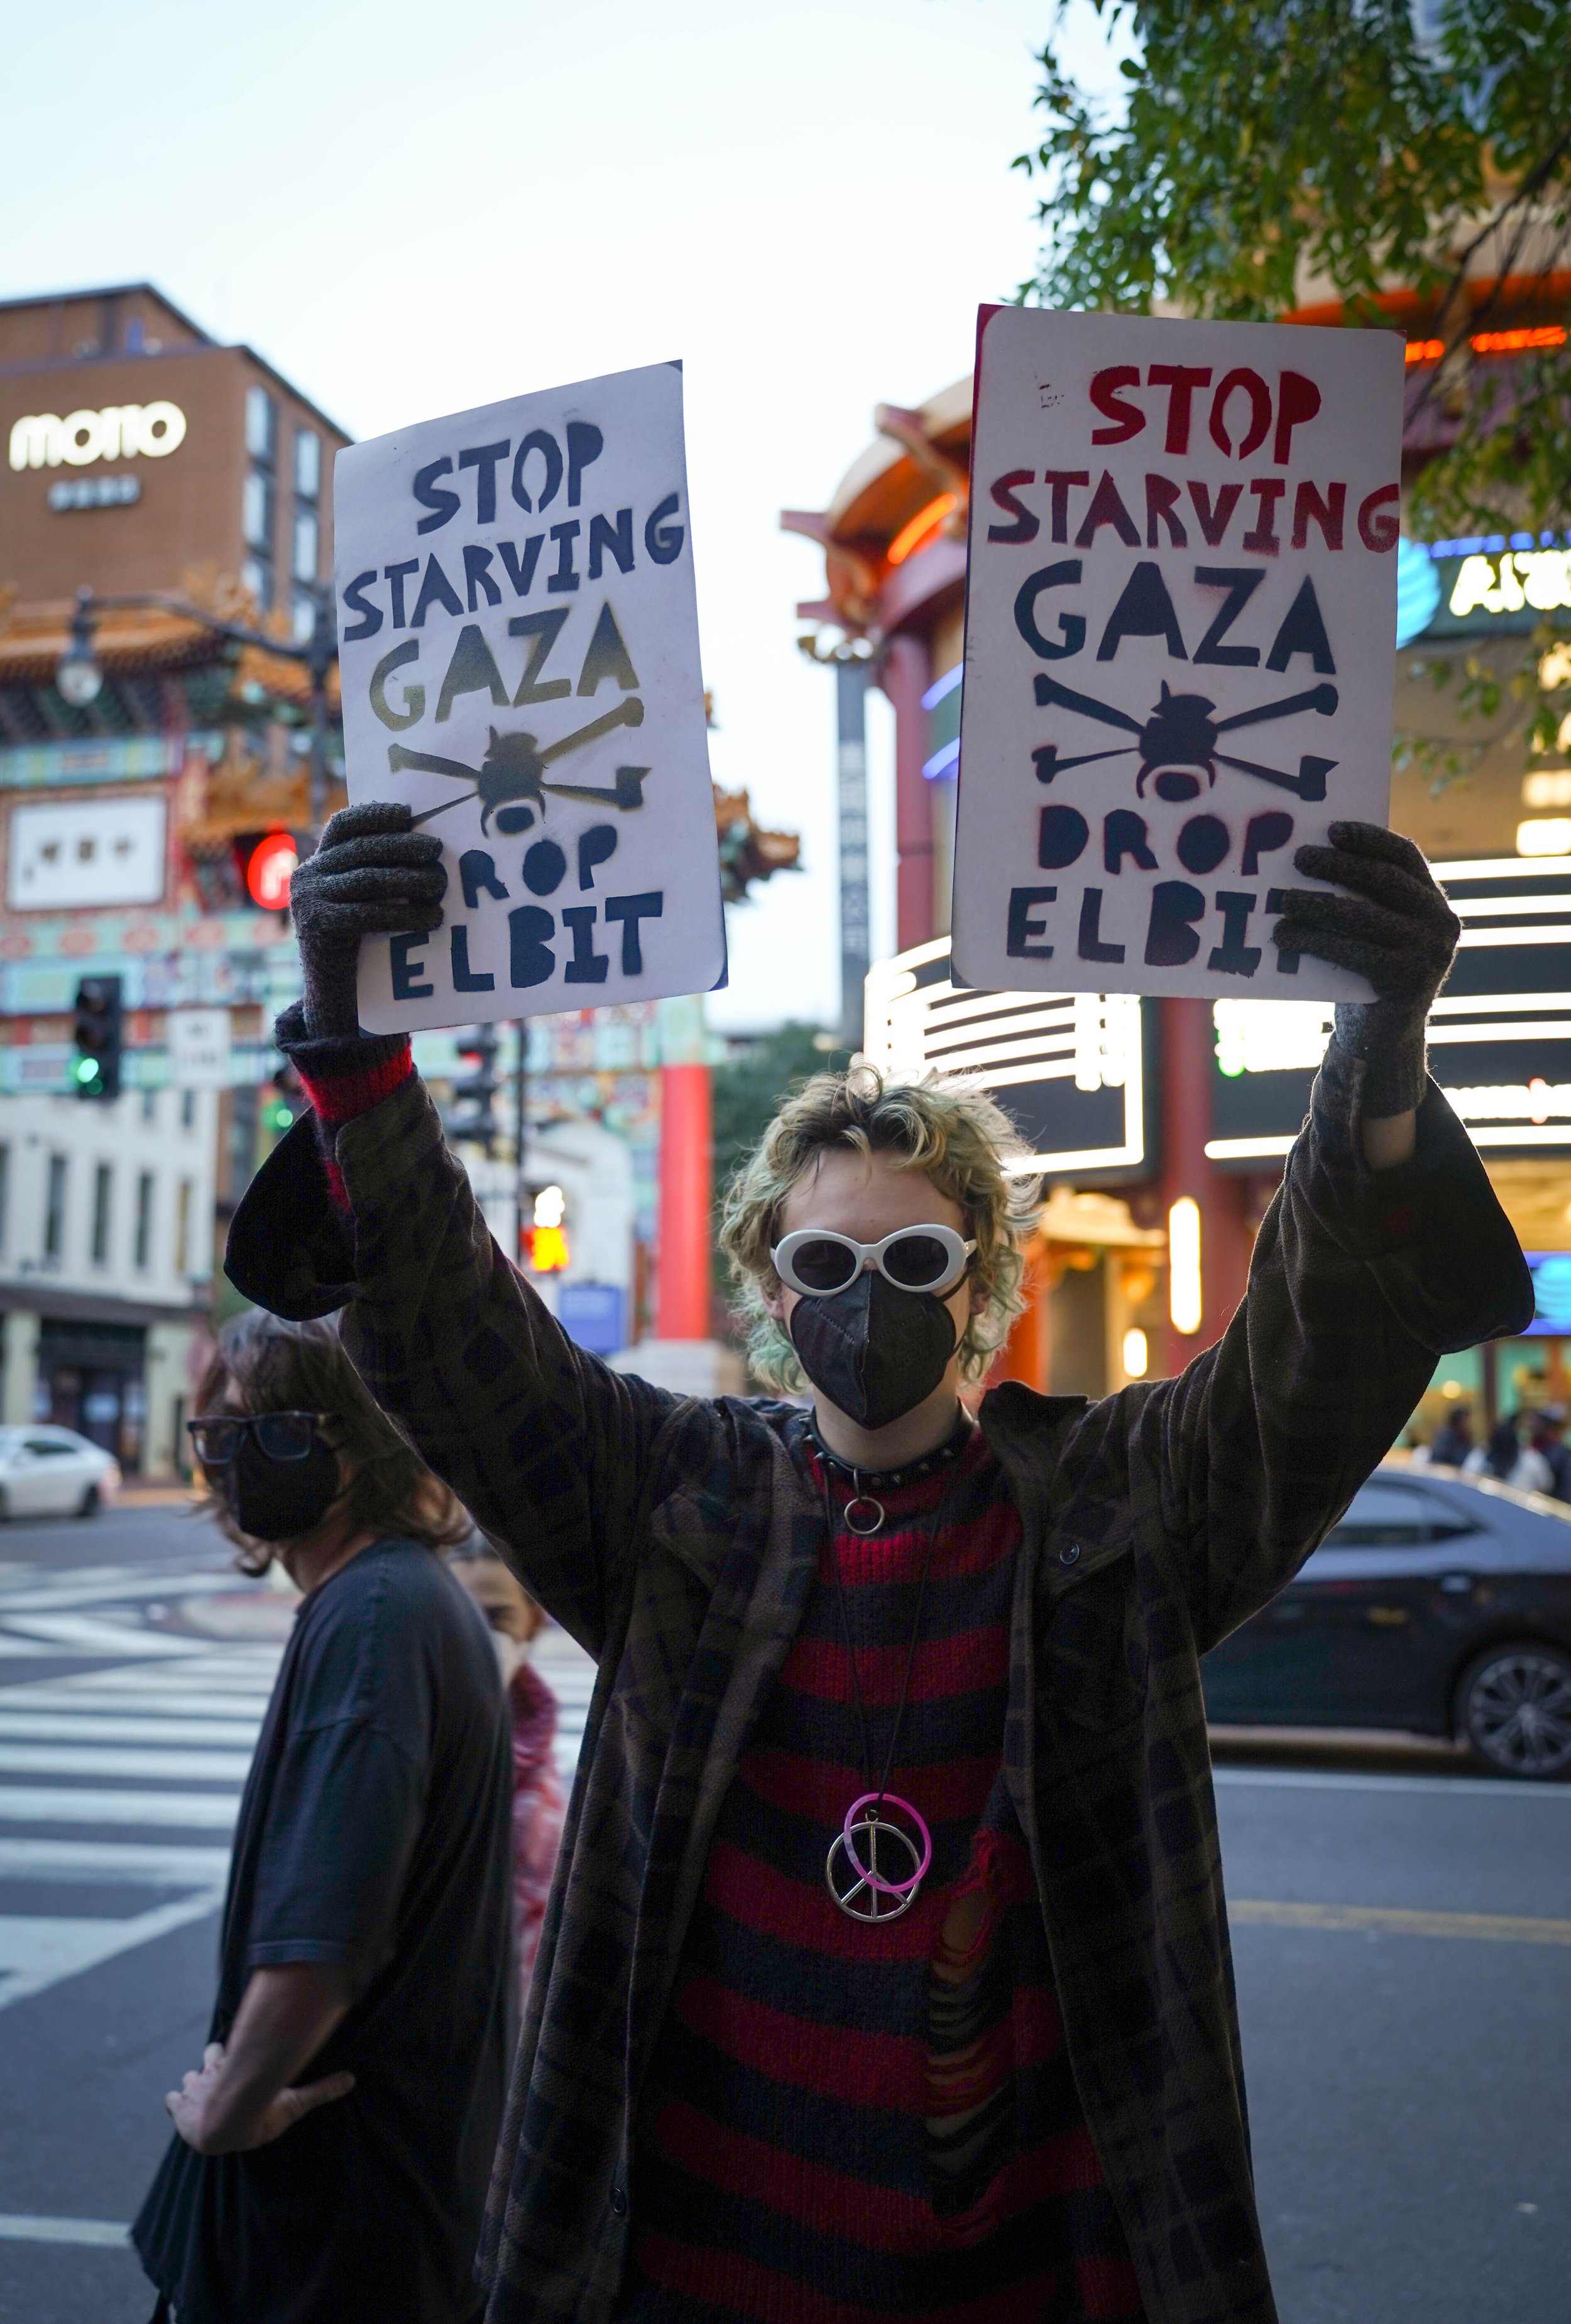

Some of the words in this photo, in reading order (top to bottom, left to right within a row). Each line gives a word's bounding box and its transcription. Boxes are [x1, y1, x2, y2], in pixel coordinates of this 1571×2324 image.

[1089, 364, 1322, 465] STOP
[412, 421, 604, 535] STOP
[987, 469, 1400, 557] STARVING
[342, 492, 685, 641] STARVING
[1014, 560, 1336, 675] GAZA
[369, 601, 640, 732] GAZA
[440, 824, 618, 908] ROP
[1037, 804, 1295, 876] DROP
[389, 891, 664, 1001] ELBIT
